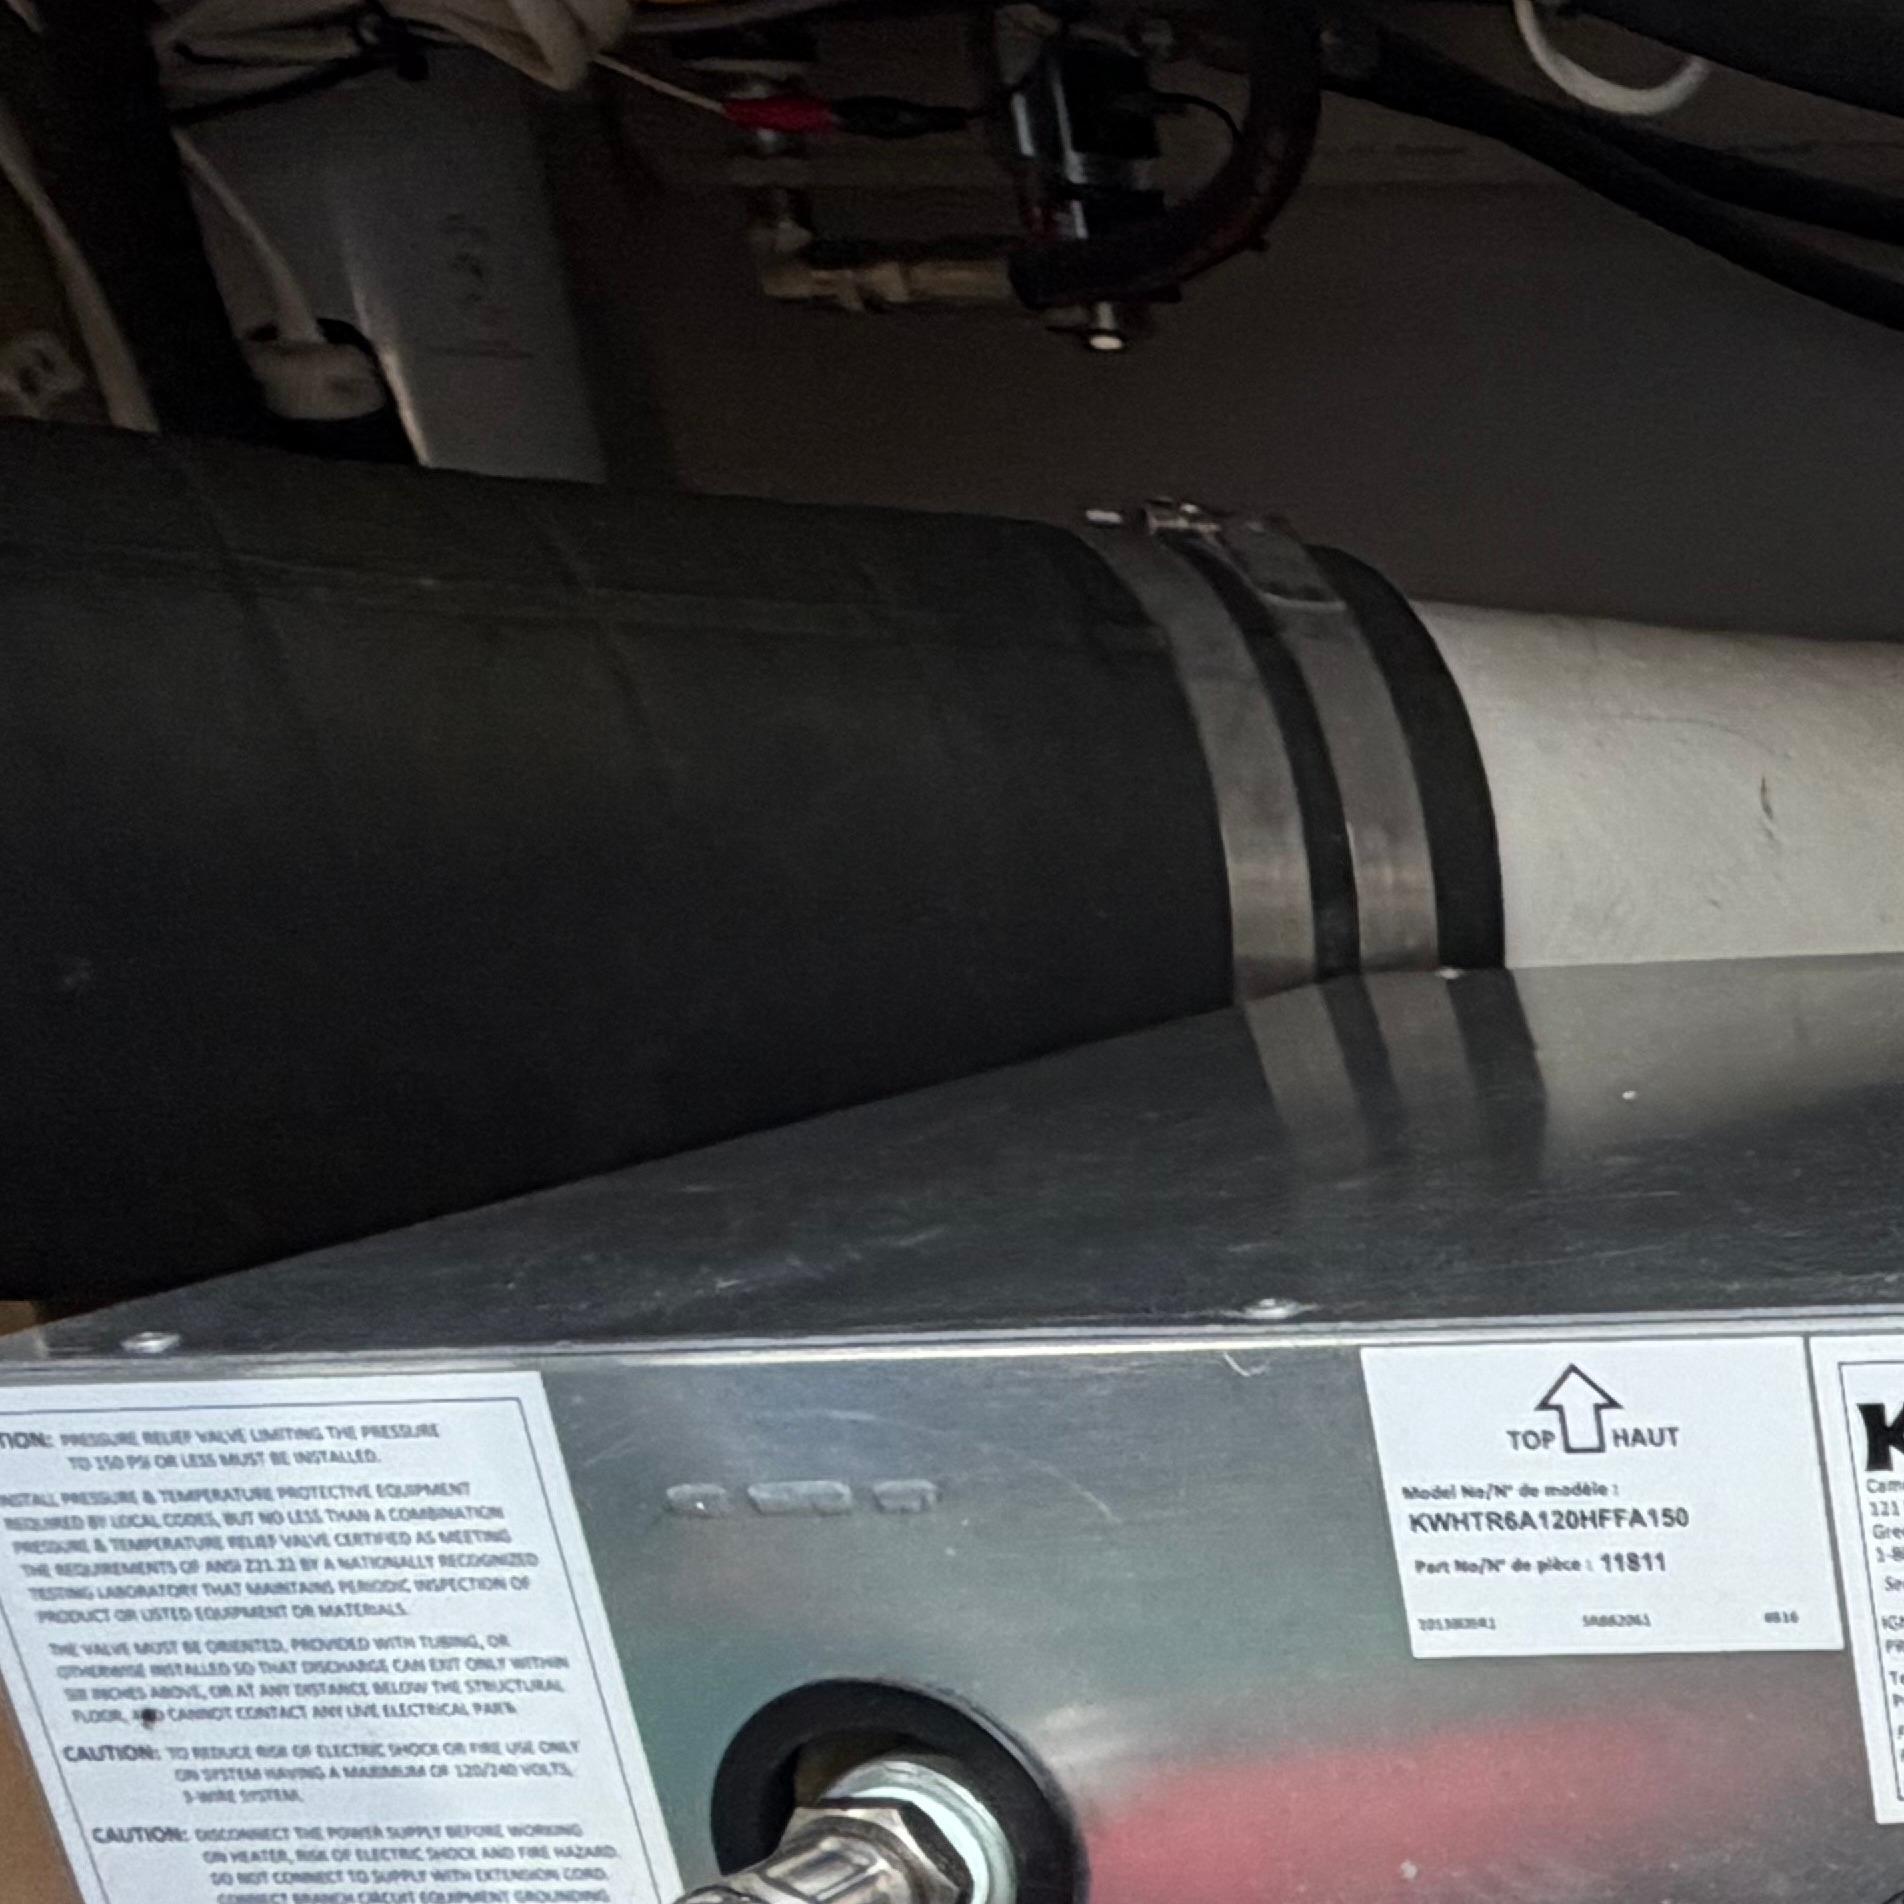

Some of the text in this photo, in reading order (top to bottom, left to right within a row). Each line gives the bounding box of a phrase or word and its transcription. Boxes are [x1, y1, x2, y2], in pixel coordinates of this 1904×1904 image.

[1507, 1429, 1556, 1451] TOP
[1612, 1426, 1679, 1448] HAUT
[1409, 1506, 1689, 1533] KWHTR6A120HFFA150
[1869, 1500, 1900, 1518] 121
[1600, 1552, 1666, 1573] 11811
[62, 1744, 161, 1762] CAUTION:
[91, 1826, 188, 1844] CAUTION:
